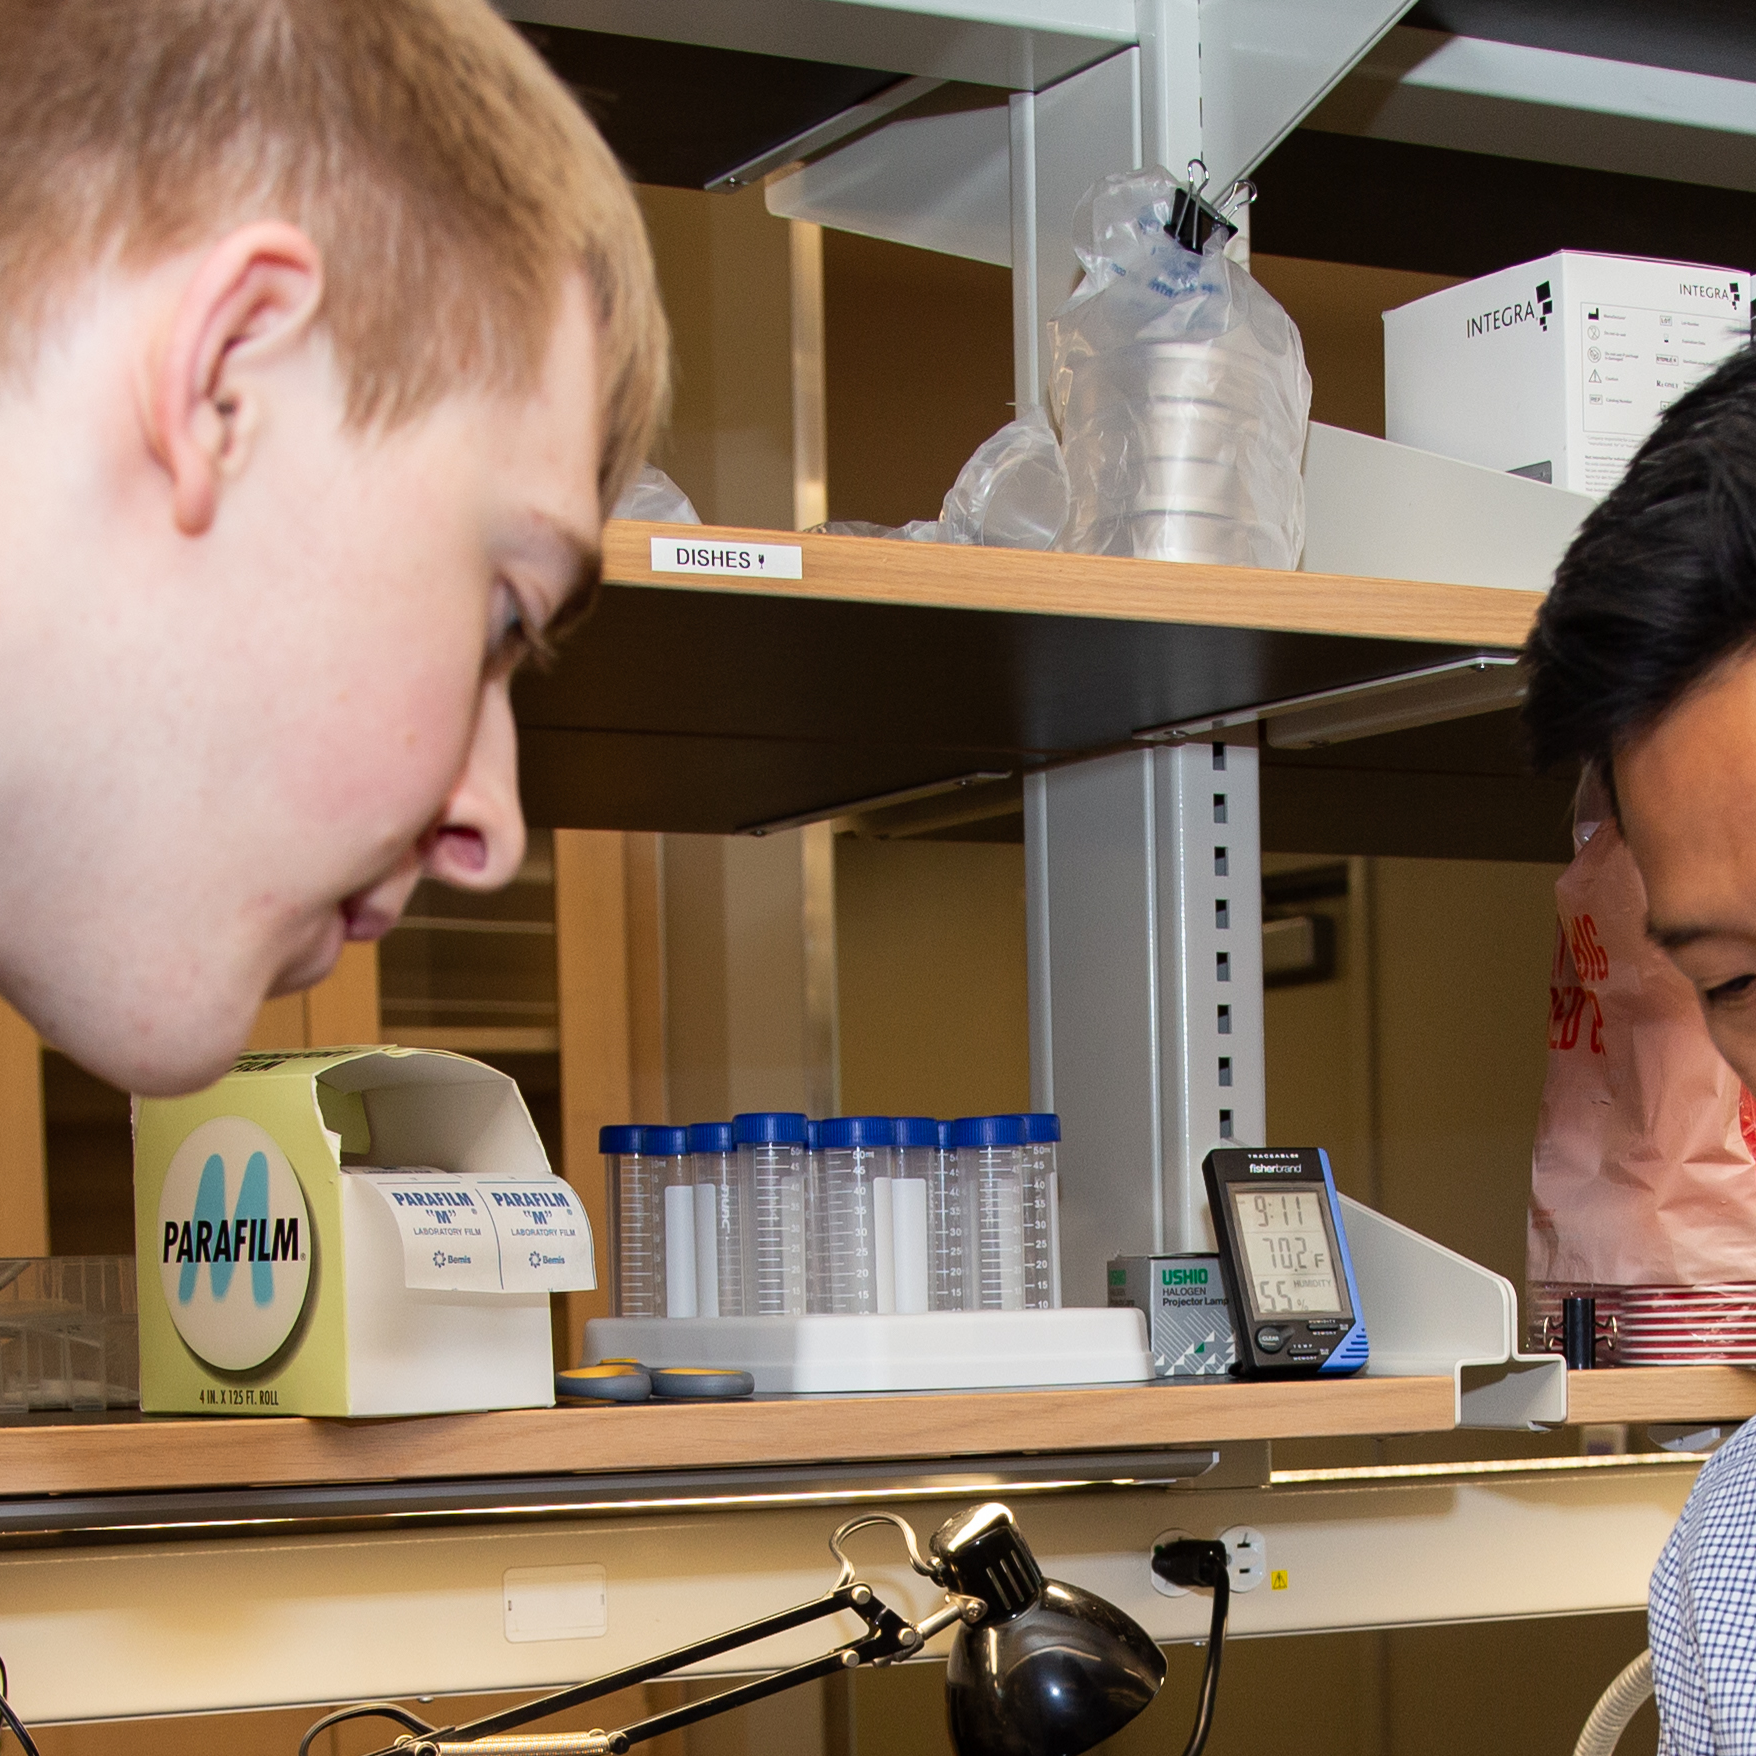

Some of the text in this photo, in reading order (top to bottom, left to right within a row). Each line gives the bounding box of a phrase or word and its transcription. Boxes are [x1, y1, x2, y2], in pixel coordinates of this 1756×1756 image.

[1679, 283, 1729, 300] INTEGRA
[1466, 301, 1536, 338] INTEGRA
[676, 547, 751, 569] DISHES
[852, 1150, 875, 1159] 50ml
[1033, 1146, 1052, 1154] 50ml
[1249, 1163, 1302, 1174] fisherbrand
[1033, 1181, 1045, 1189] 40
[854, 1187, 867, 1195] 40
[391, 1191, 475, 1207] PARAFILM
[491, 1191, 570, 1207] PARAFILM
[1034, 1200, 1046, 1208] 35
[854, 1207, 867, 1215] 35
[1253, 1195, 1304, 1228] 9:11
[1035, 1221, 1047, 1229] 30
[413, 1227, 482, 1236] LABORATORY FILM
[511, 1228, 576, 1237] LABORATORY FILM
[163, 1218, 299, 1264] PARAFILM
[1035, 1240, 1047, 1248] 25
[855, 1248, 868, 1256] 25
[1262, 1237, 1307, 1273] 70.2
[447, 1255, 472, 1264] Bemis
[542, 1255, 566, 1265] Bemis
[1035, 1260, 1048, 1268] 20
[856, 1269, 869, 1277] 20
[1162, 1268, 1209, 1286] USHIO
[1037, 1281, 1048, 1289] 15
[1293, 1278, 1333, 1289] HUMIDITY
[857, 1291, 870, 1299] 15
[1163, 1287, 1207, 1297] HALOGEN
[1259, 1281, 1294, 1313] 55
[1038, 1301, 1049, 1309] 10
[1163, 1298, 1230, 1308] Projector Lamp
[199, 1390, 279, 1405] 4 IN. X 125 FT. ROLL
